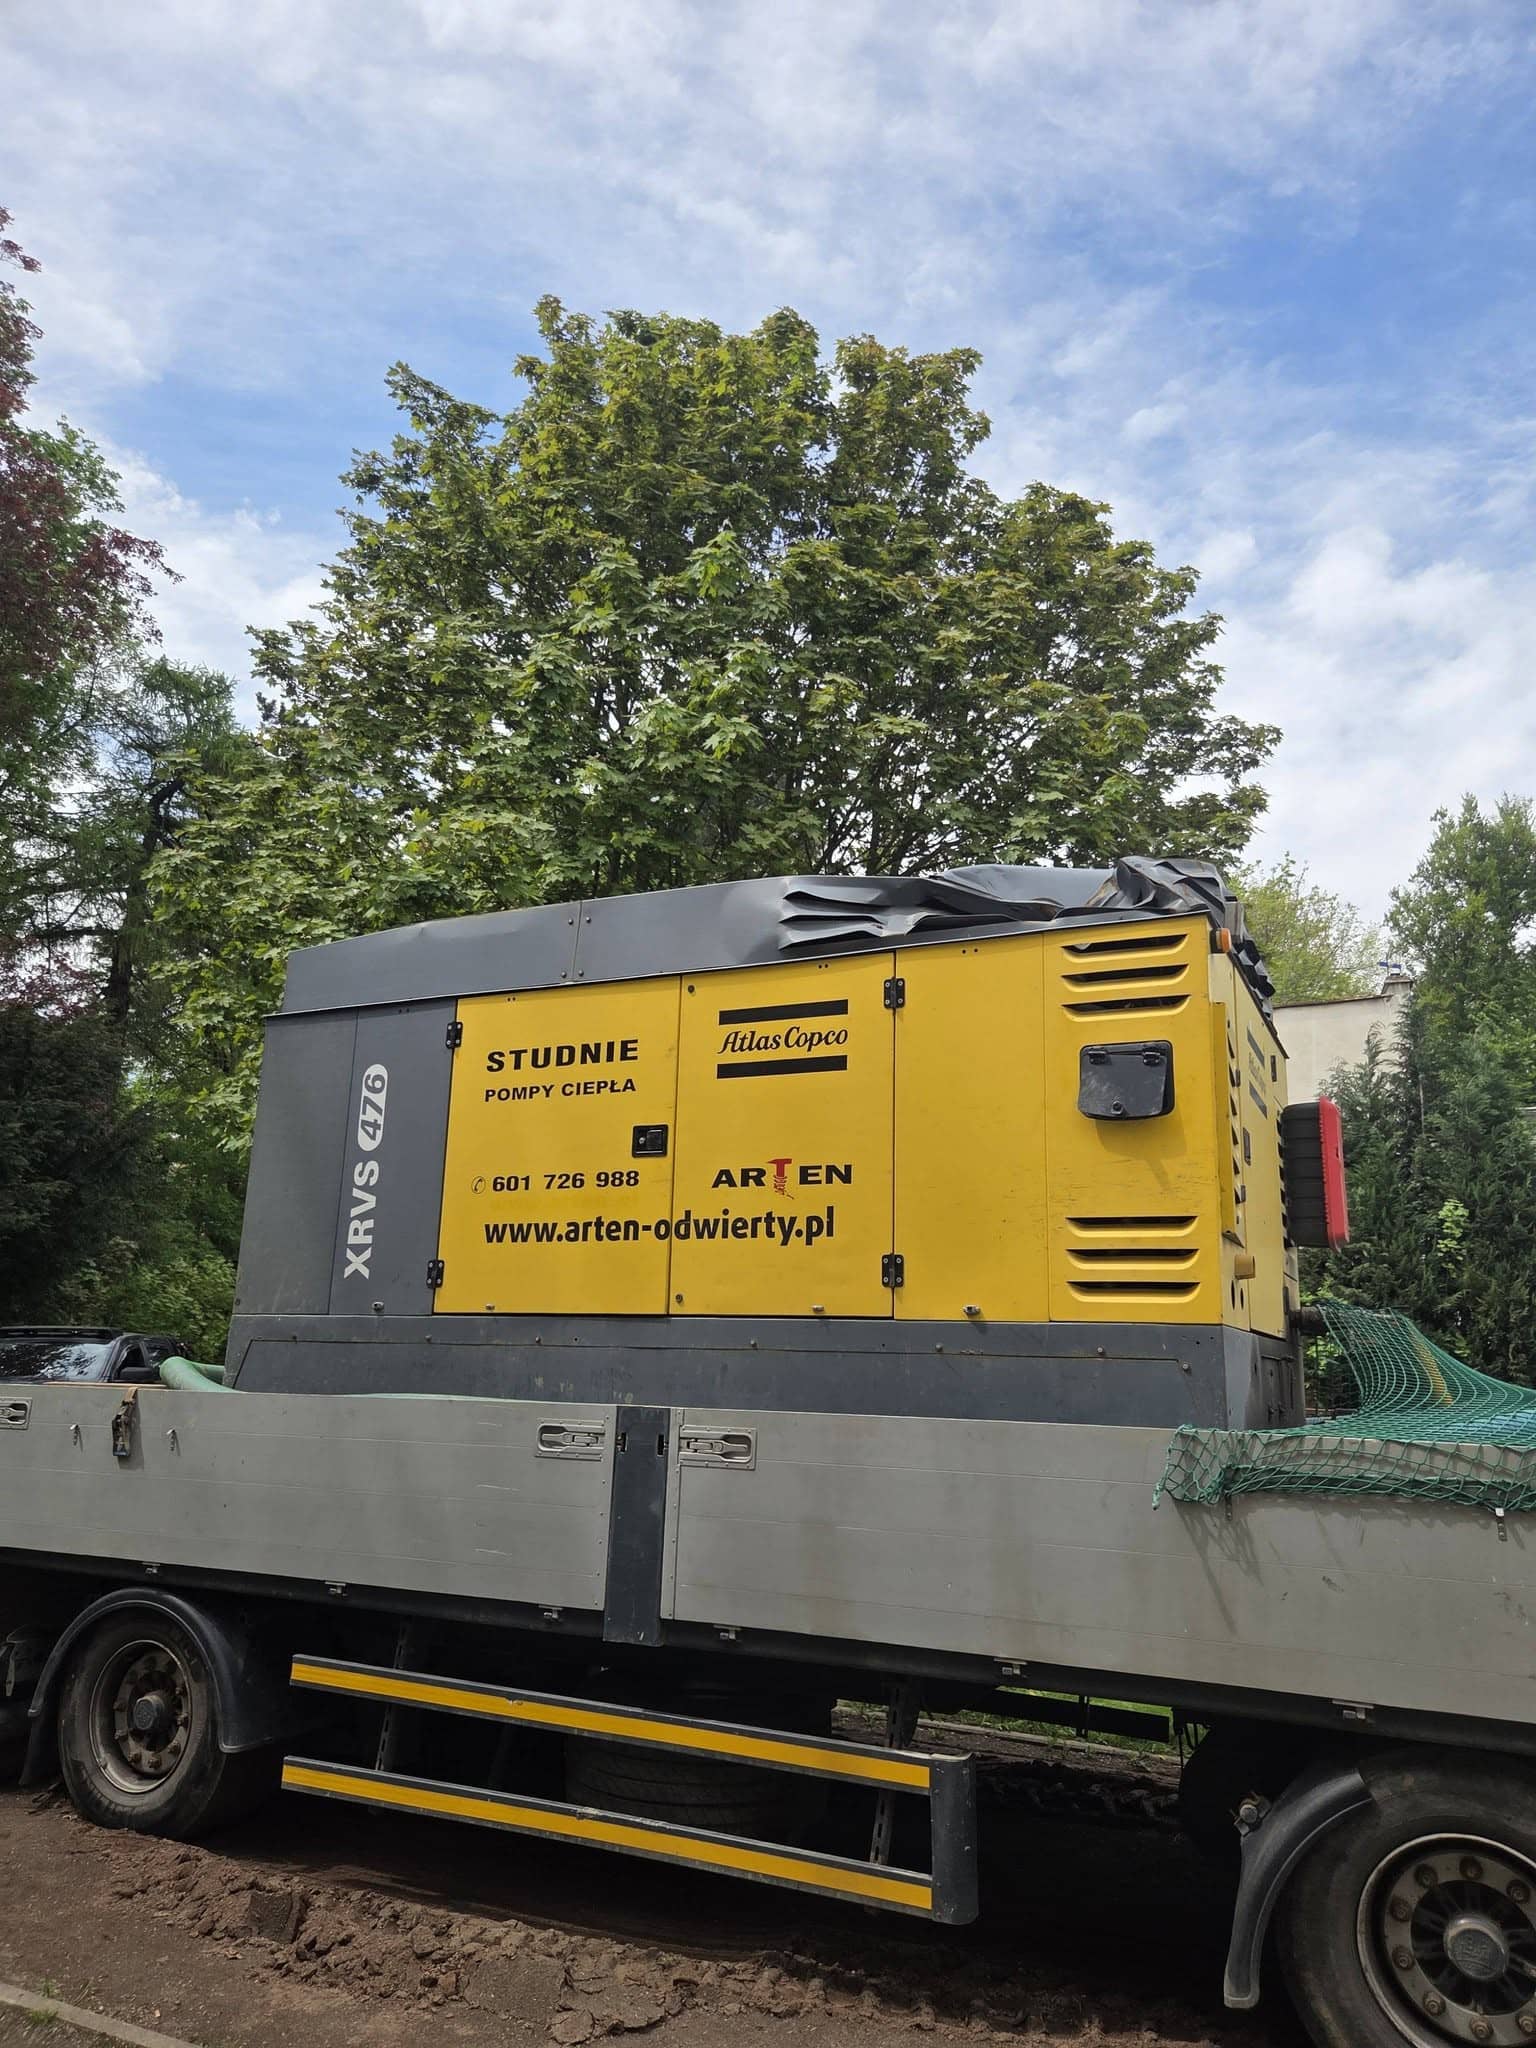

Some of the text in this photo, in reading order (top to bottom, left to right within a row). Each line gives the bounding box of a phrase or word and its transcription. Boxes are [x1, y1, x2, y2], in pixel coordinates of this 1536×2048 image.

[486, 1039, 639, 1073] STUDNIE
[717, 1026, 849, 1055] Atlas Copco
[484, 1078, 636, 1102] POMPY CIEPŁA
[343, 1073, 386, 1280] XRVS 476
[492, 1170, 640, 1193] 601 726 988
[711, 1158, 853, 1199] ARTEN
[484, 1206, 834, 1247] www.arten-odwierty.pl
